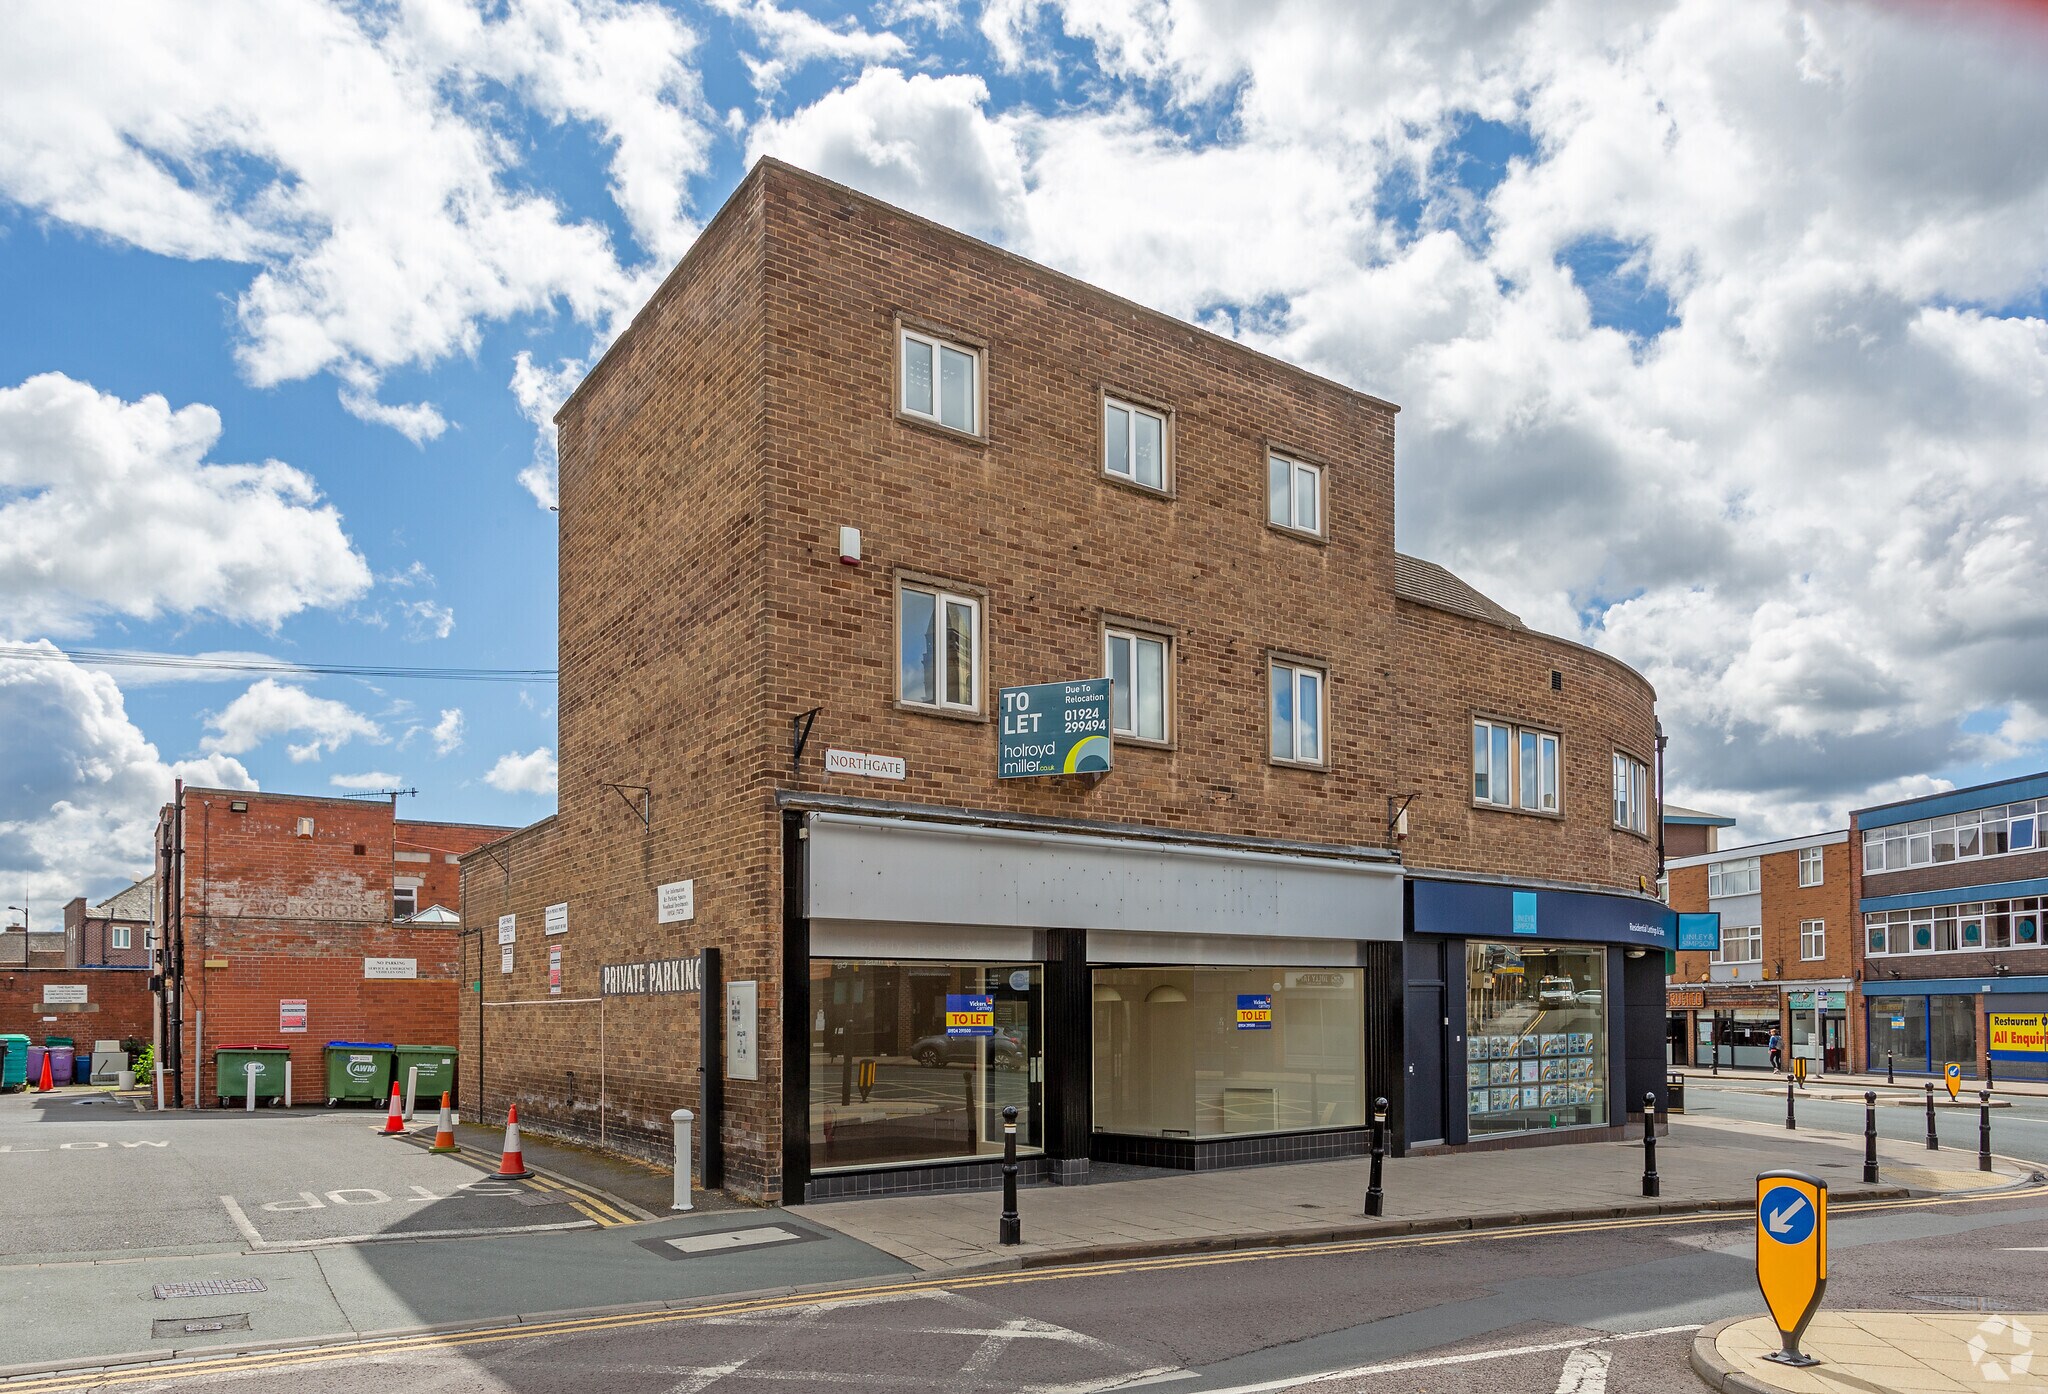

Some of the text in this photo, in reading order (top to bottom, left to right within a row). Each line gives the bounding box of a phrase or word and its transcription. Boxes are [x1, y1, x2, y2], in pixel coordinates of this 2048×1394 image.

[1065, 684, 1091, 694] Due To
[1003, 691, 1030, 713] TO
[1065, 693, 1104, 704] Relocation
[1064, 707, 1100, 721] 01924
[1004, 712, 1043, 735] LET
[1064, 719, 1106, 734] 299494
[1004, 740, 1056, 759] holroyd
[830, 754, 902, 774] NORTHGATE
[254, 901, 370, 918] WORKSHOPS
[604, 964, 645, 994] PRIVATE
[952, 1014, 968, 1025] TO
[971, 1014, 988, 1024] LET
[1242, 1011, 1267, 1020] TO LET
[1994, 1016, 2037, 1026] Restaurant
[1994, 1031, 2008, 1044] All
[353, 1064, 376, 1072] AWM
[260, 1182, 524, 1212] STOP
